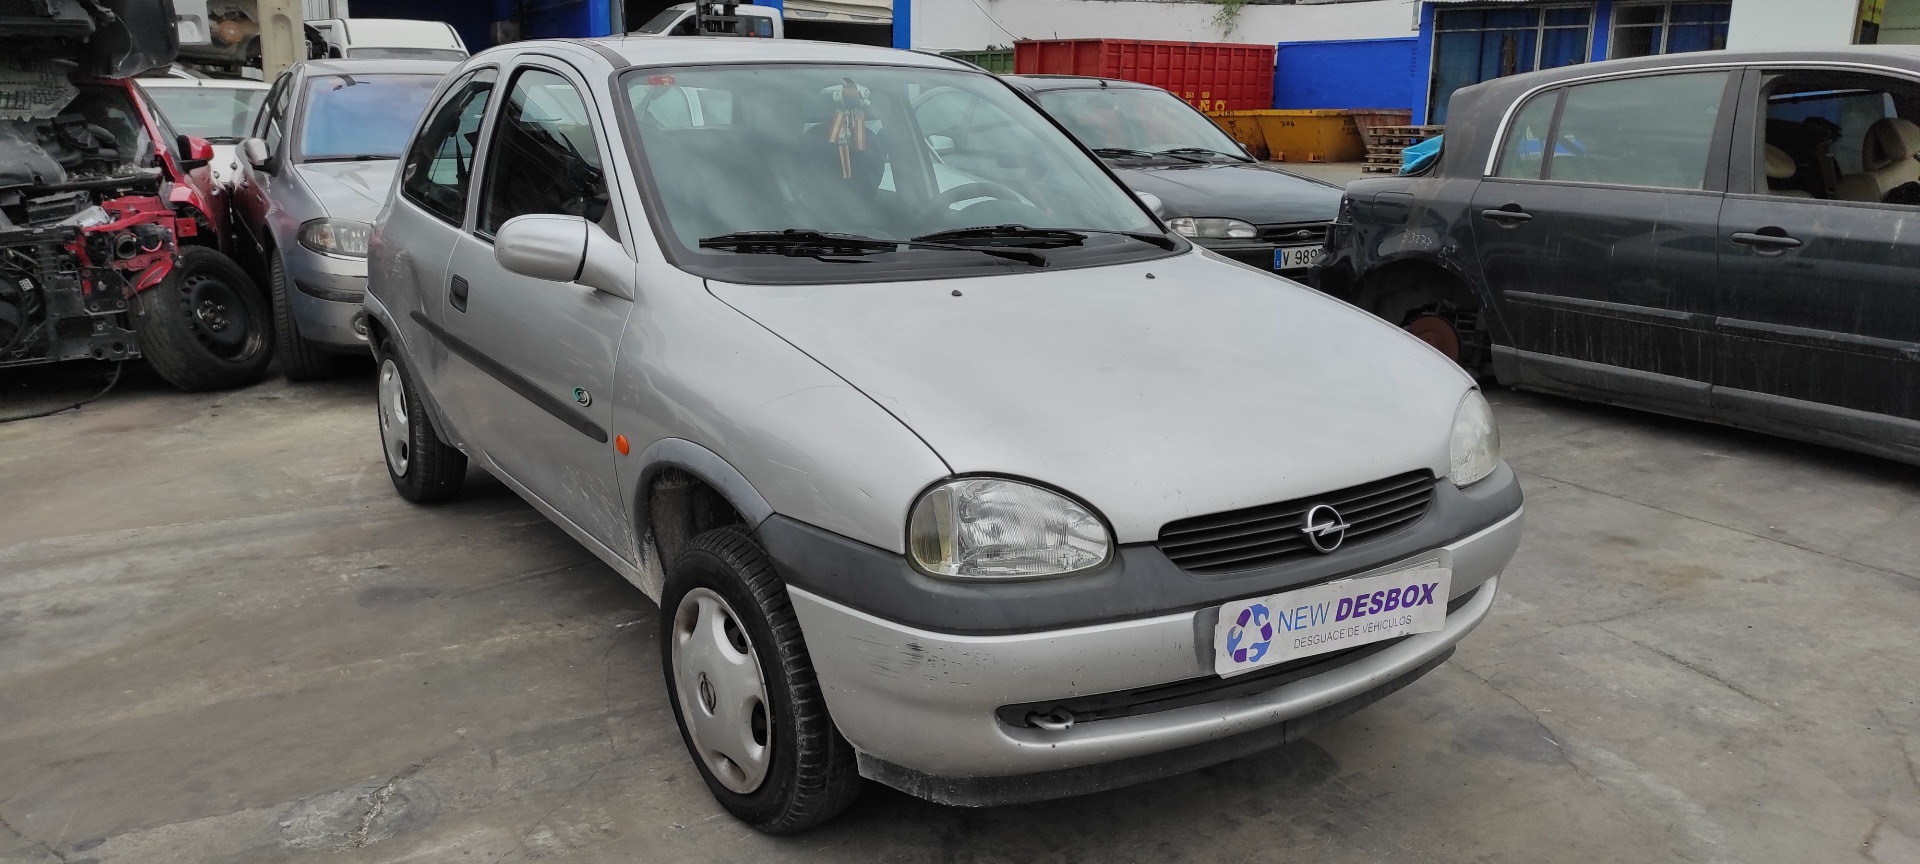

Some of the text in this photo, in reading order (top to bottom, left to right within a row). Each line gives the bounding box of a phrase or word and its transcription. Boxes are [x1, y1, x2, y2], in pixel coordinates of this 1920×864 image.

[1283, 251, 1290, 268] V
[1278, 582, 1439, 634] NEW DESBOX
[1294, 630, 1345, 649] DESGUACE
[1347, 627, 1360, 638] DE
